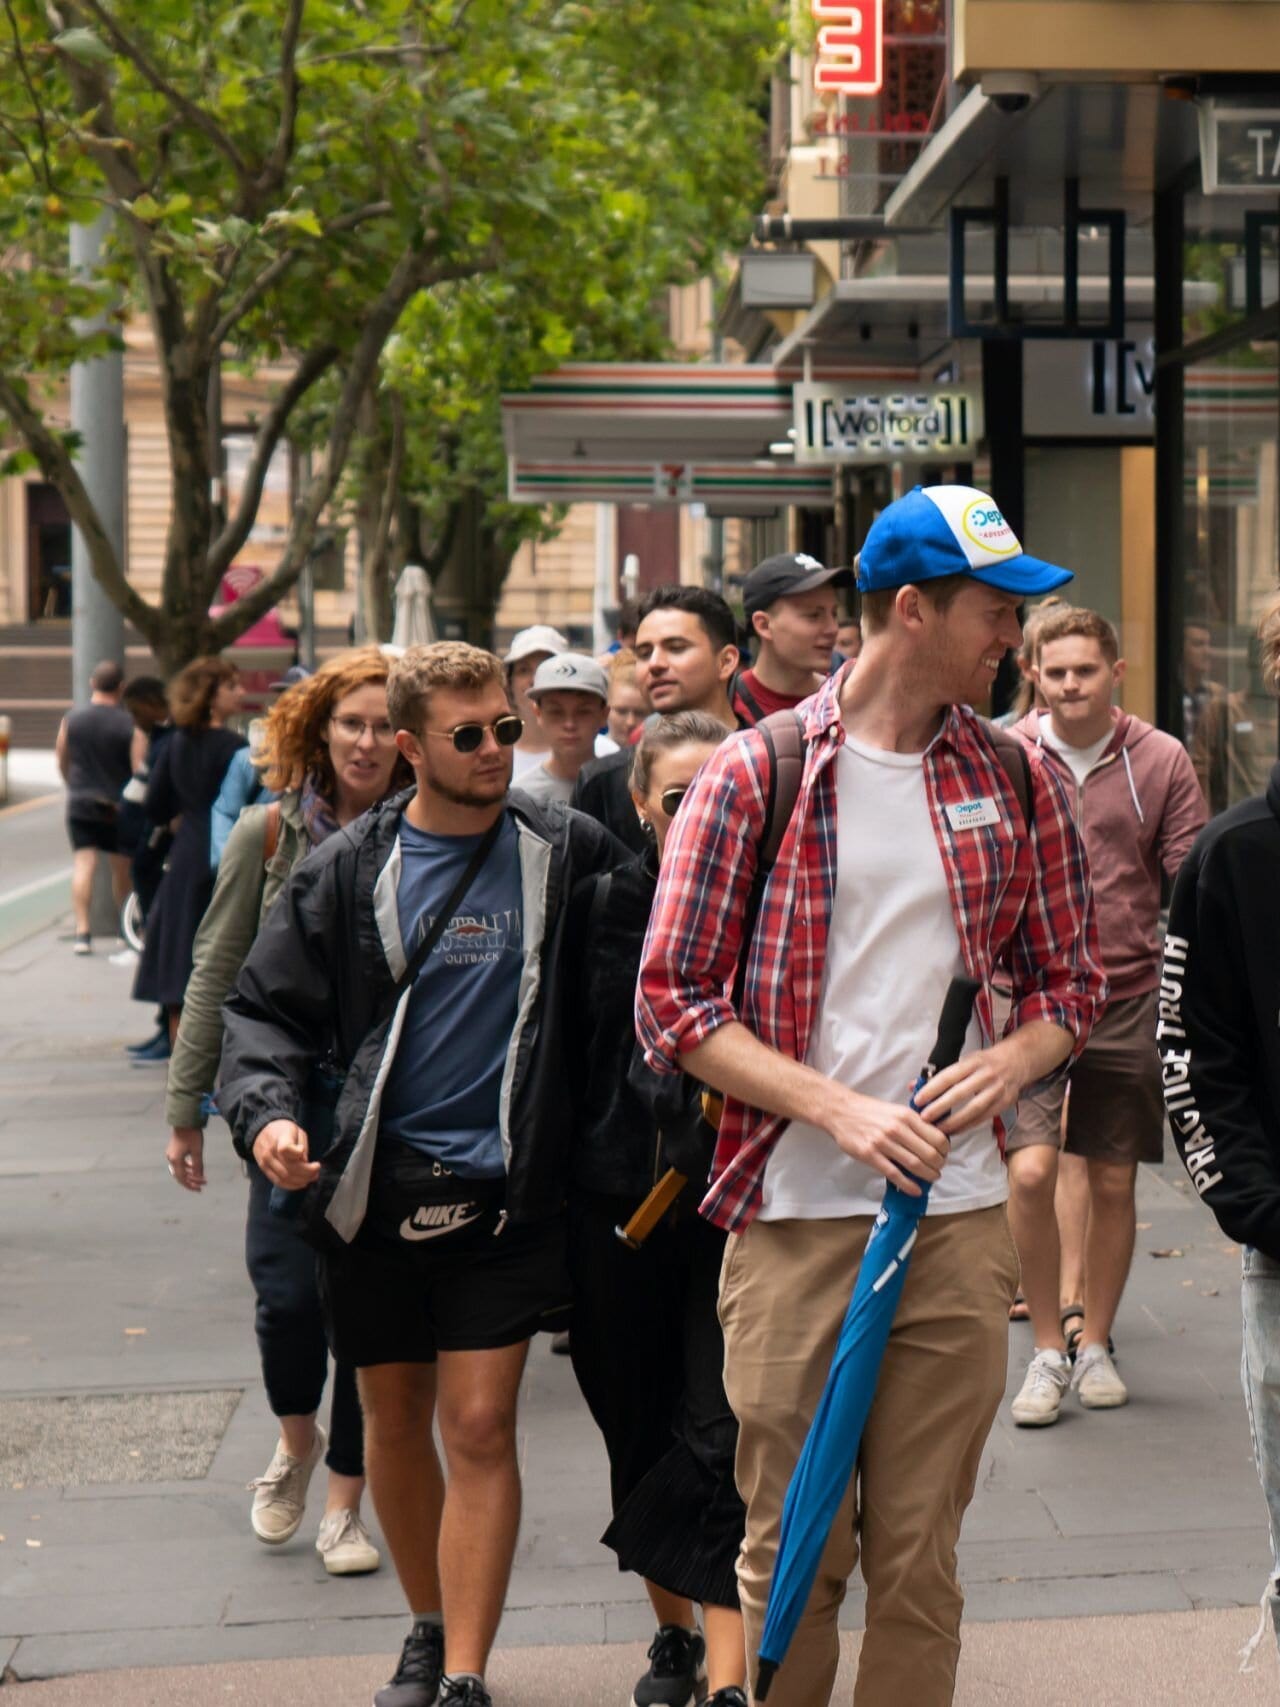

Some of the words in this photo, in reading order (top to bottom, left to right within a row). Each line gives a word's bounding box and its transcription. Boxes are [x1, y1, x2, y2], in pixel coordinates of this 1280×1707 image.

[834, 410, 939, 435] Wolford
[445, 951, 500, 965] OUTBACK
[1156, 934, 1190, 1041] TRUTH
[1157, 1048, 1224, 1195] PRACTICE
[414, 1203, 470, 1226] NIKE
